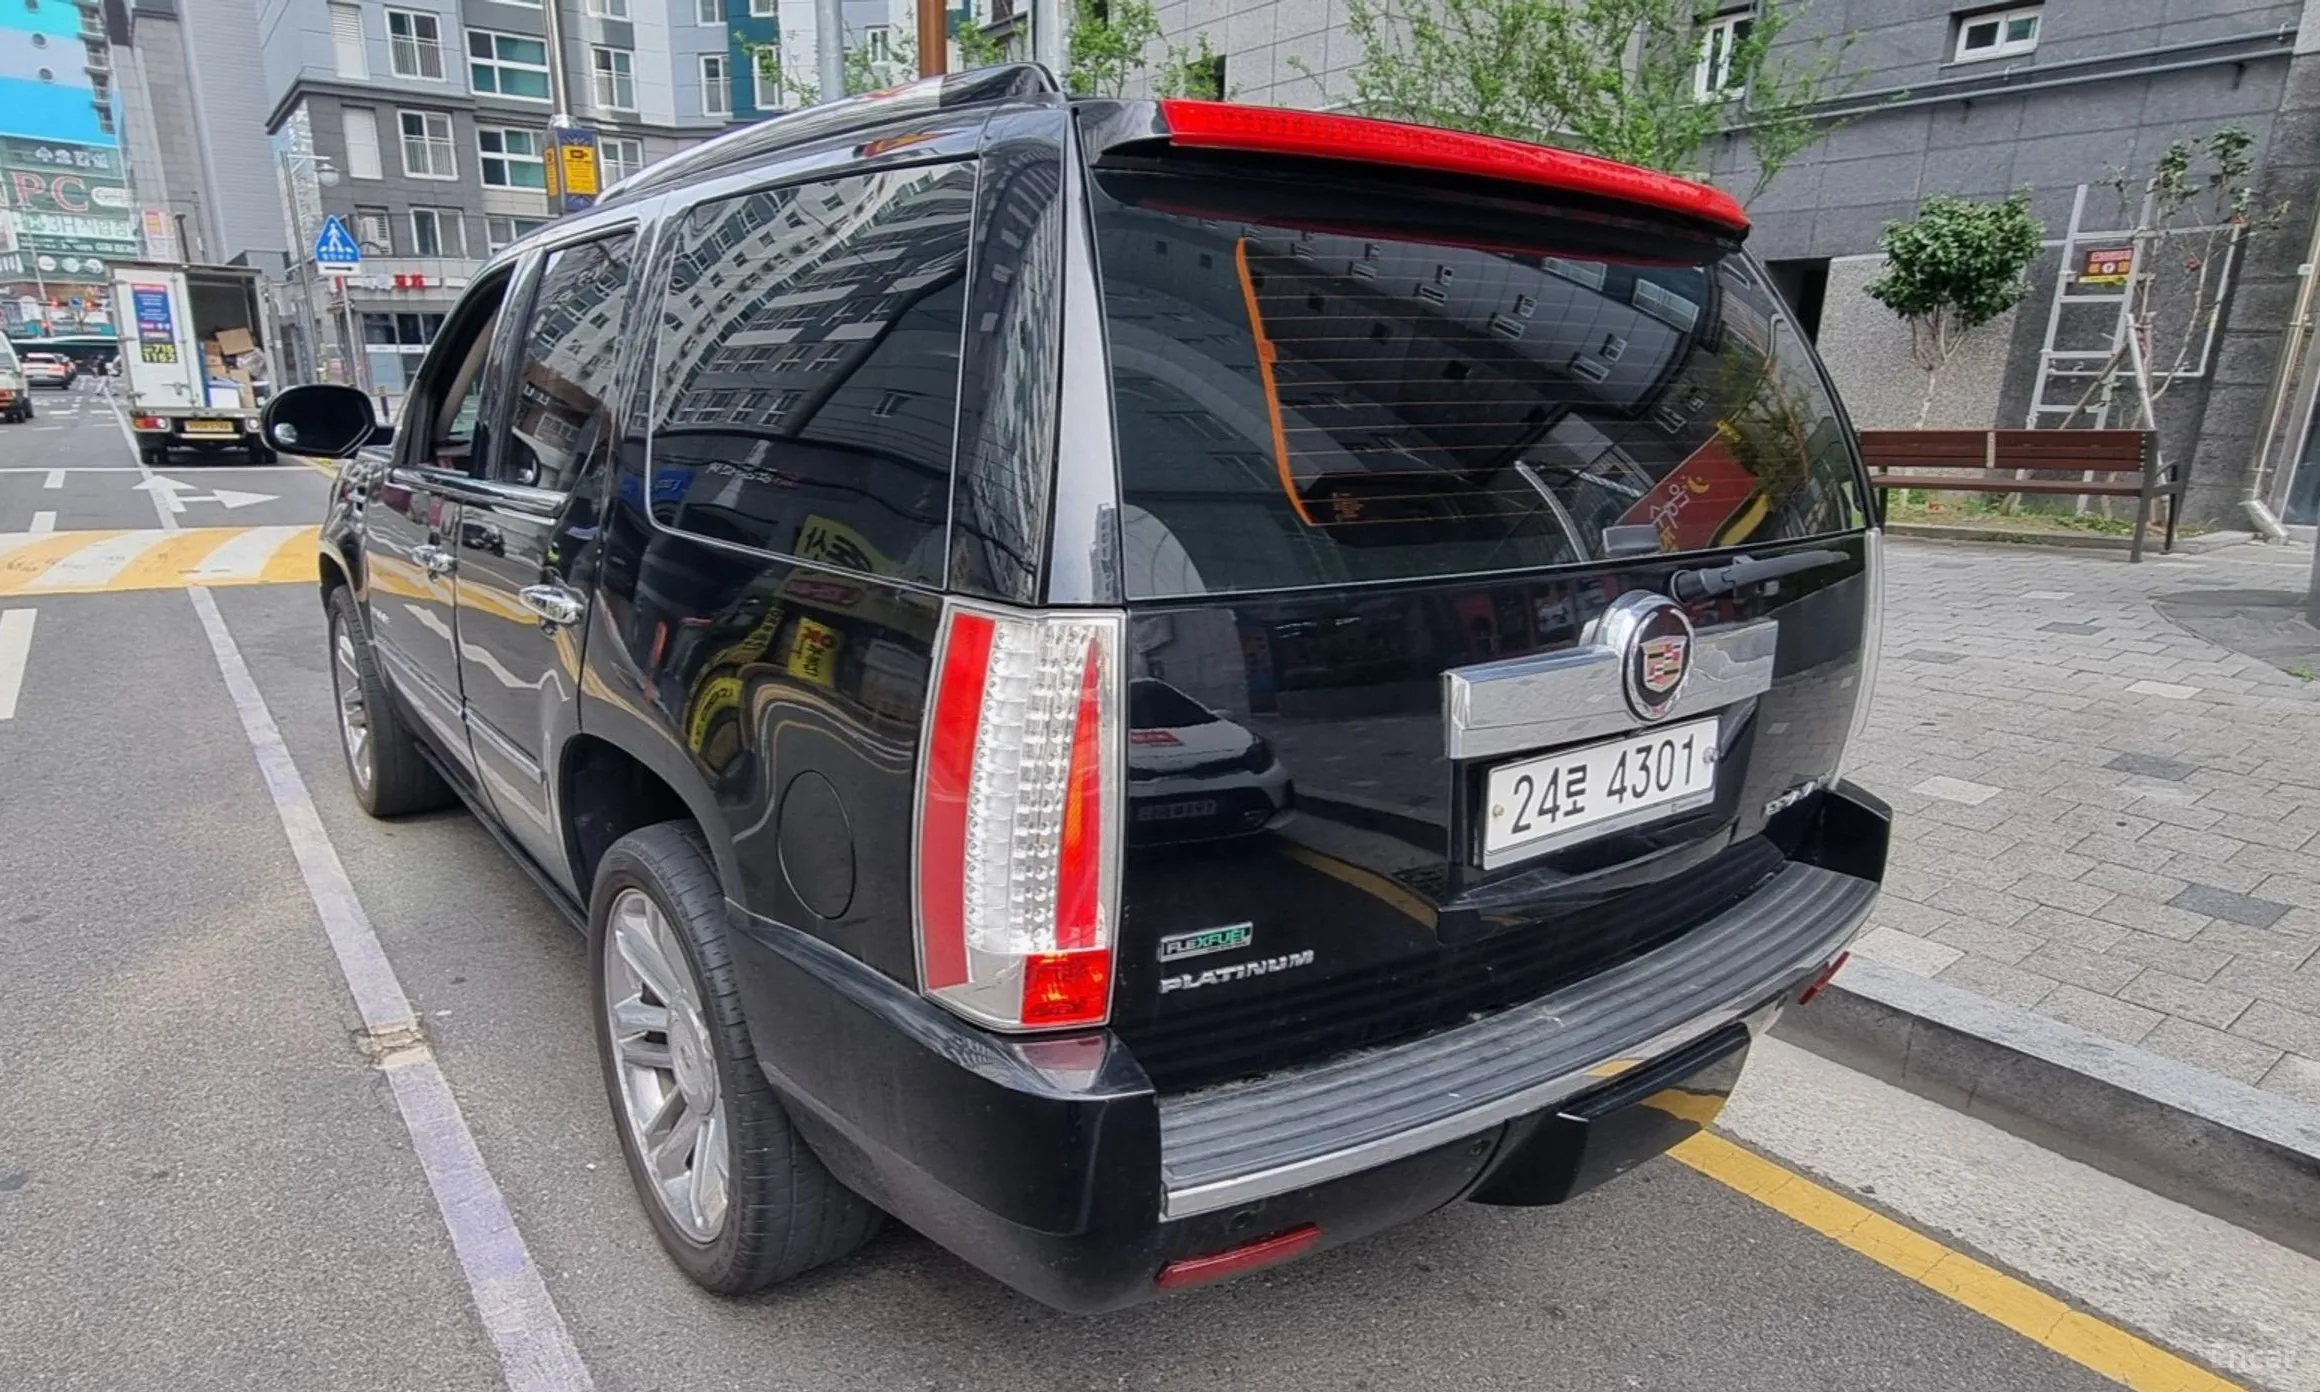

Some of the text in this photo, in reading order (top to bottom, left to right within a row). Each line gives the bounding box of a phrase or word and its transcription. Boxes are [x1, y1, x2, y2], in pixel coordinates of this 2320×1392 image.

[10, 171, 89, 212] PC
[1511, 763, 1588, 834] 24로
[1606, 733, 1694, 804] 4301
[1166, 928, 1248, 954] FLEXFUEL
[1158, 949, 1315, 994] PLATINUM
